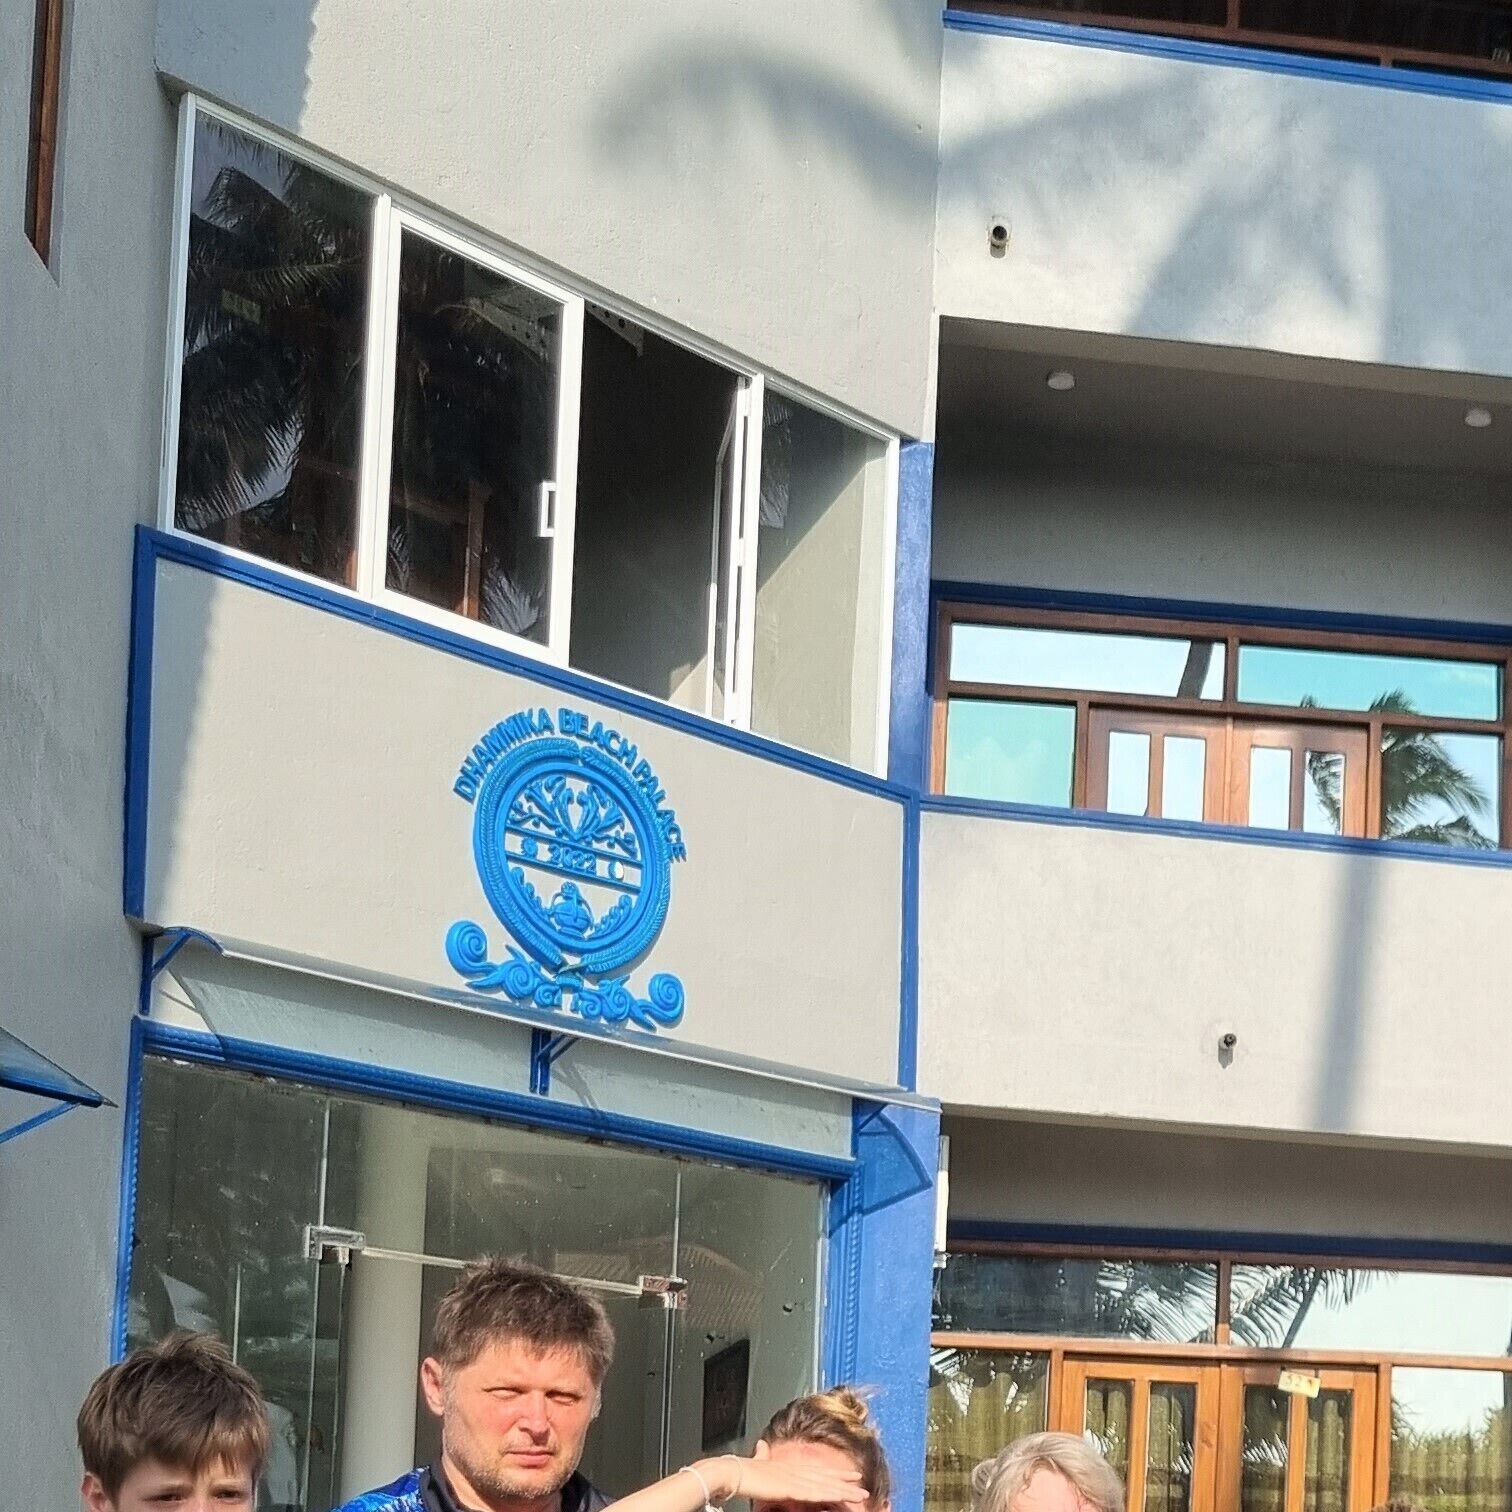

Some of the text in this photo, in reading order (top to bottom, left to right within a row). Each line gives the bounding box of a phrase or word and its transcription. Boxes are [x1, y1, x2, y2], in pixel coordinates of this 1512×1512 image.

[453, 707, 688, 864] DHAMMIKA BEACH PALACE
